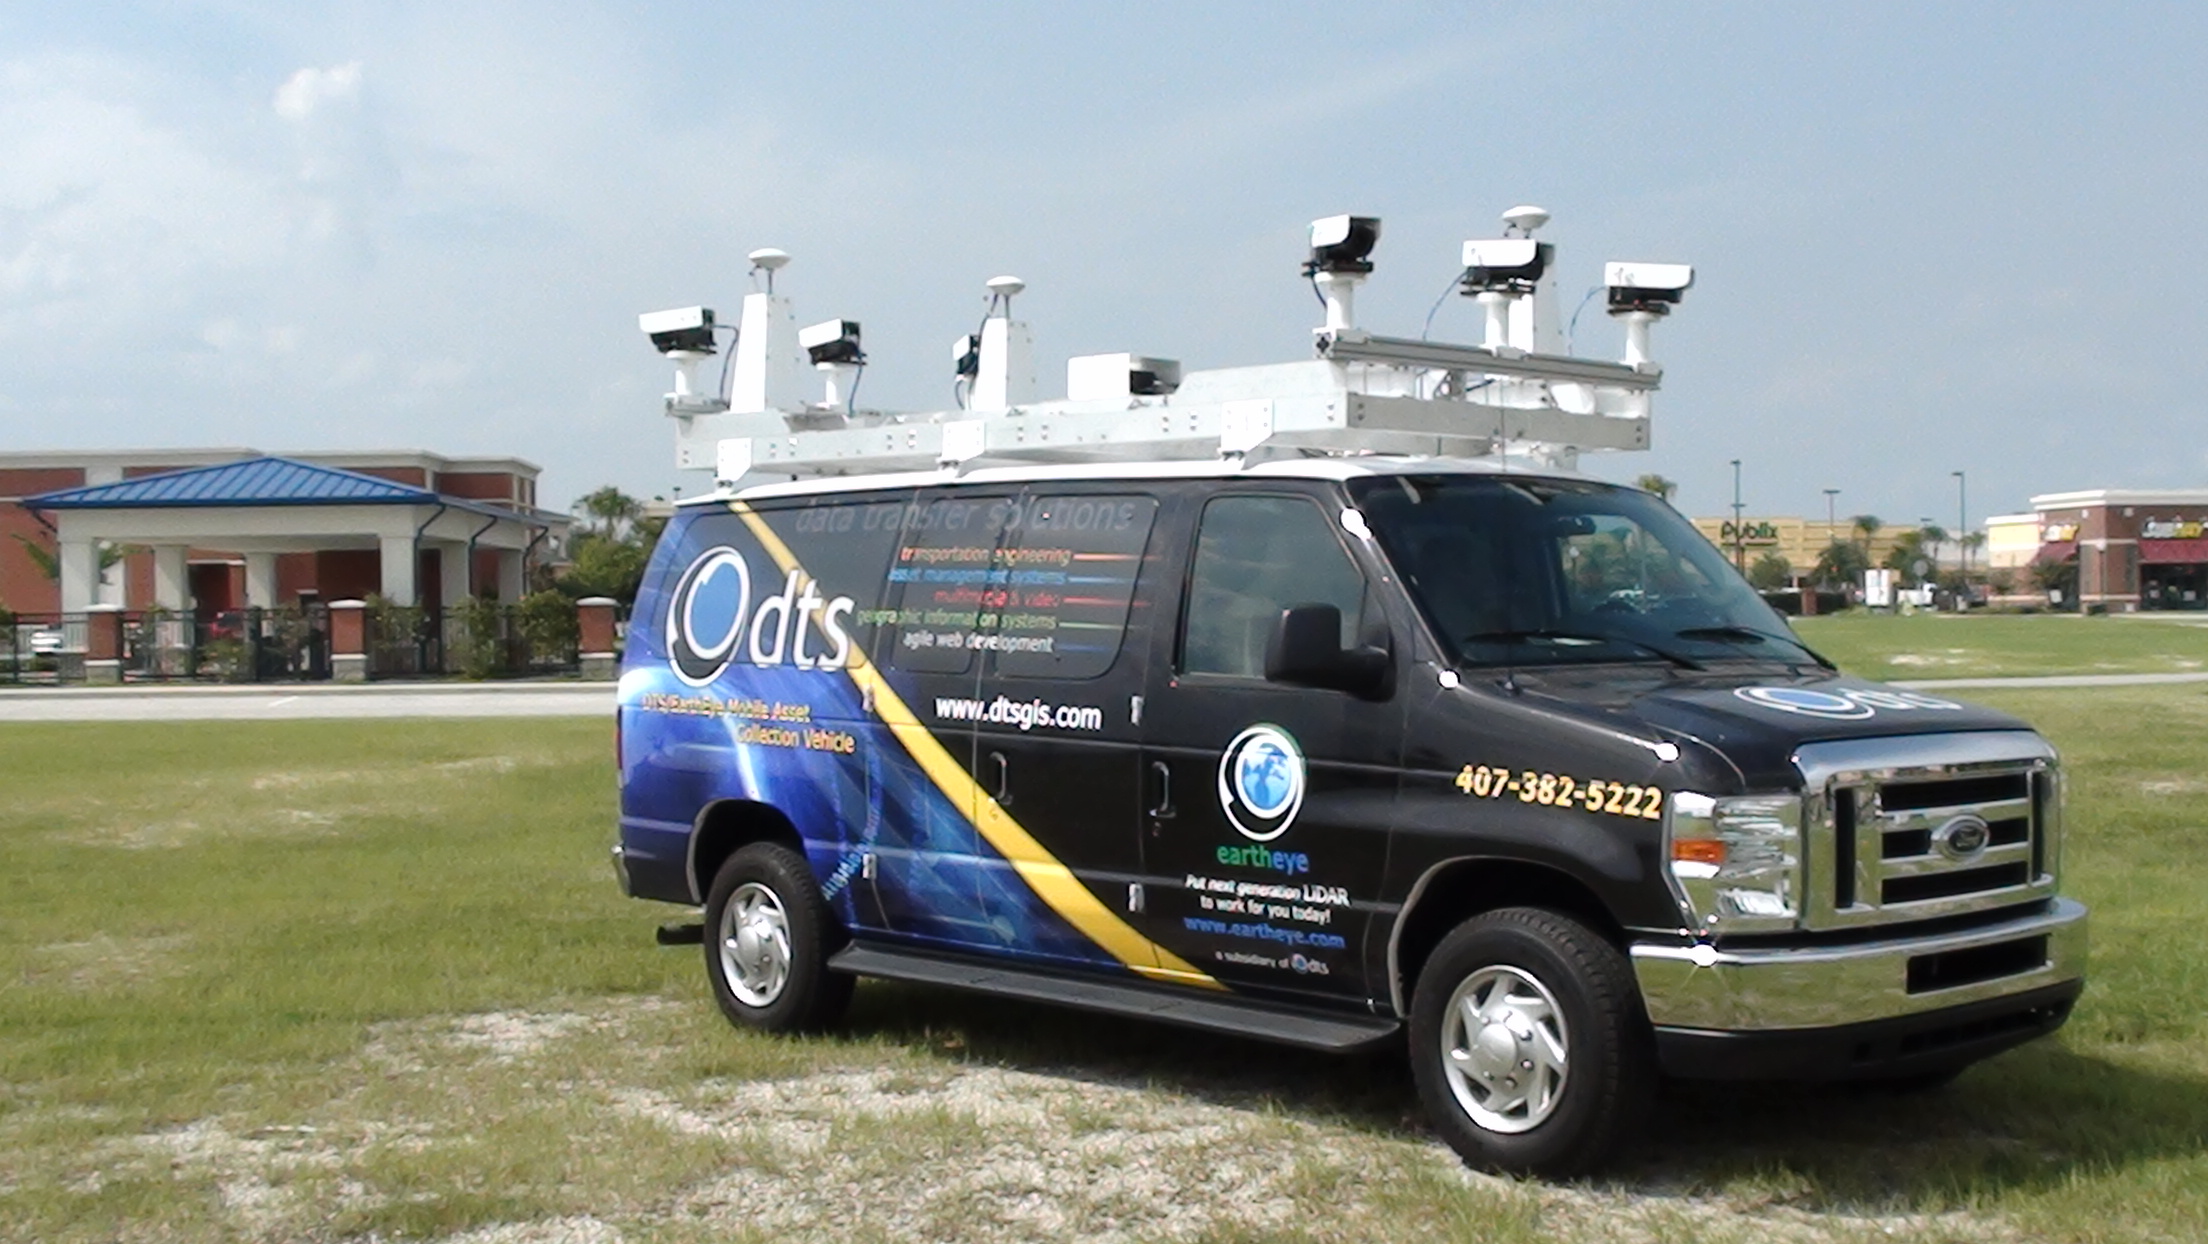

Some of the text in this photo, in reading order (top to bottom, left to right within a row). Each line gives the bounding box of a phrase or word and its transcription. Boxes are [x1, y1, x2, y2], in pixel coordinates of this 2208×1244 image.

[795, 496, 1136, 532] data transfer solutions
[1721, 521, 1778, 539] Publix
[901, 547, 1072, 566] transportation engineering
[1010, 570, 1066, 585] systems
[1024, 590, 1060, 606] video
[856, 609, 921, 627] geographic
[1001, 612, 1057, 629] systems
[902, 630, 1054, 653] agile web development
[727, 699, 769, 720] Mobile
[771, 701, 811, 722] Asset
[935, 695, 1102, 731] www.dtsgis.com
[736, 723, 855, 754] Collection Vehicle
[1455, 764, 1663, 820] 407-382-5222
[1216, 844, 1309, 875] eartheye
[1185, 873, 1206, 890] Put
[1207, 878, 1235, 893] next
[1237, 881, 1301, 900] generation
[1200, 895, 1331, 926] to work for you today!
[1183, 916, 1347, 949] www.eartheye.com
